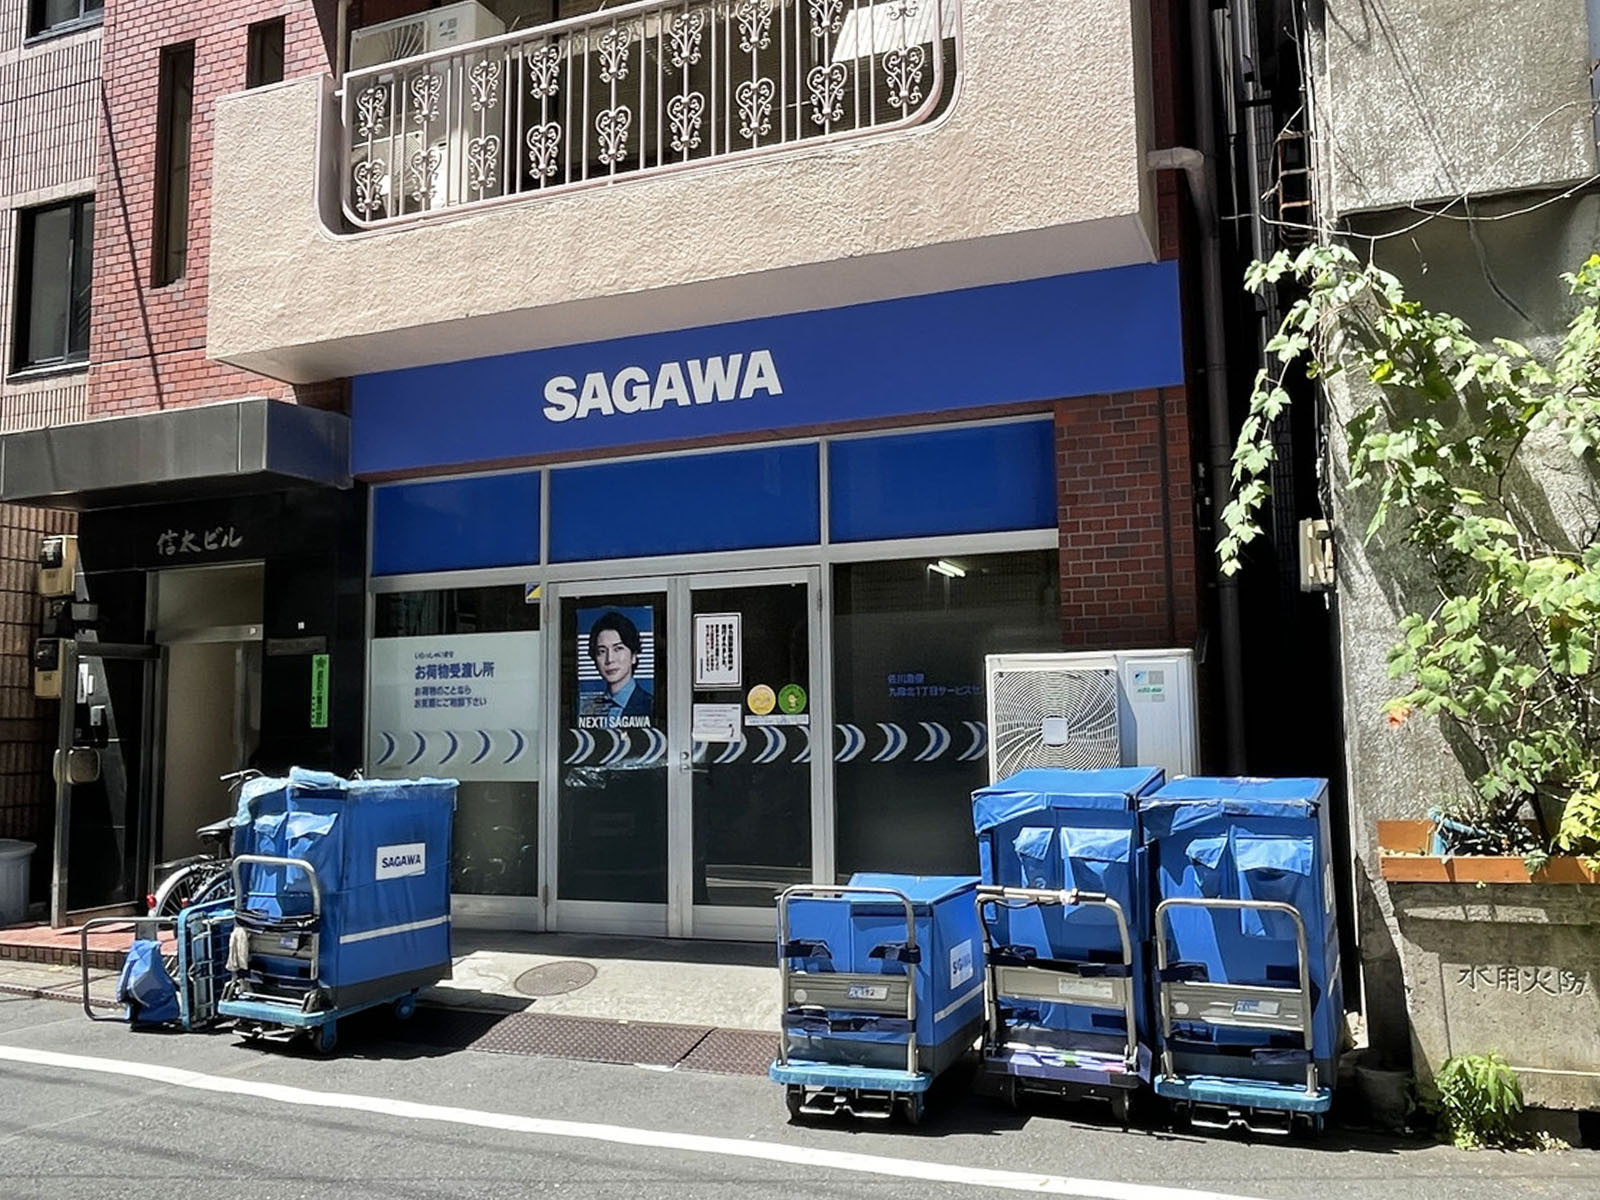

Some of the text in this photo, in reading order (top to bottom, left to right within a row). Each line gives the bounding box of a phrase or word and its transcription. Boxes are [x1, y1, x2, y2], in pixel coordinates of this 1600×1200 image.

[543, 349, 783, 422] SAGAWA
[415, 662, 494, 680] お荷物受渡し所
[608, 715, 651, 728] SAGAWA
[381, 854, 421, 868] SAGAWA
